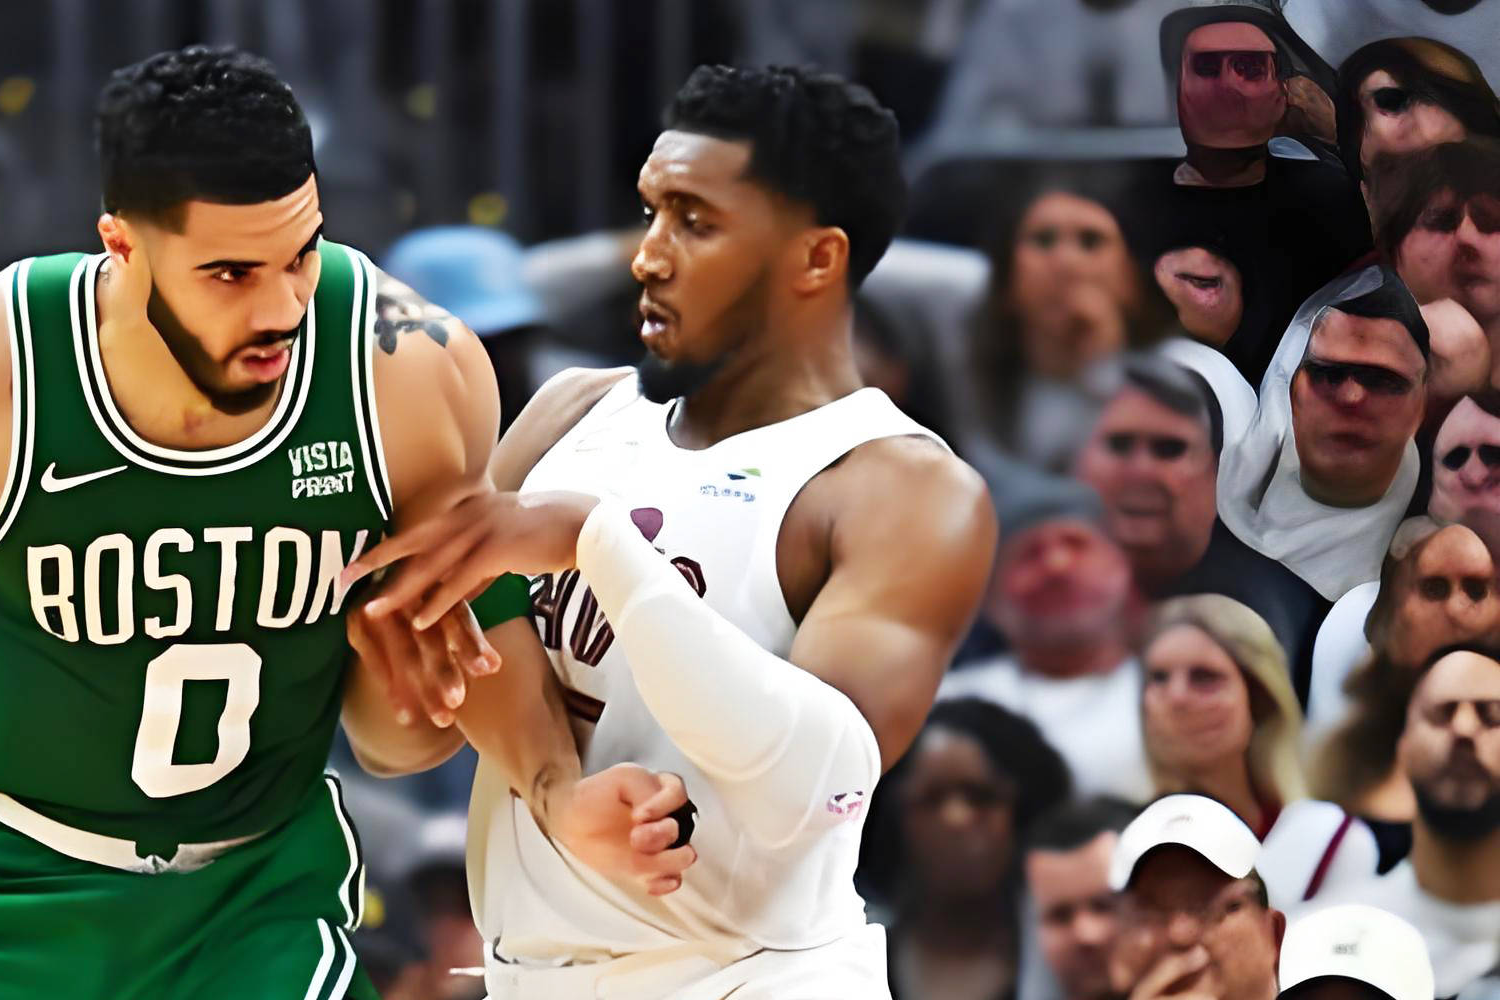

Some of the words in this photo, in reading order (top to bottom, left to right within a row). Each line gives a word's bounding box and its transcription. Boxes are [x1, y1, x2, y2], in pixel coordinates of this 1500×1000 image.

[288, 441, 355, 477] VISTA
[26, 525, 369, 646] BOSTON
[131, 643, 263, 799] 0
